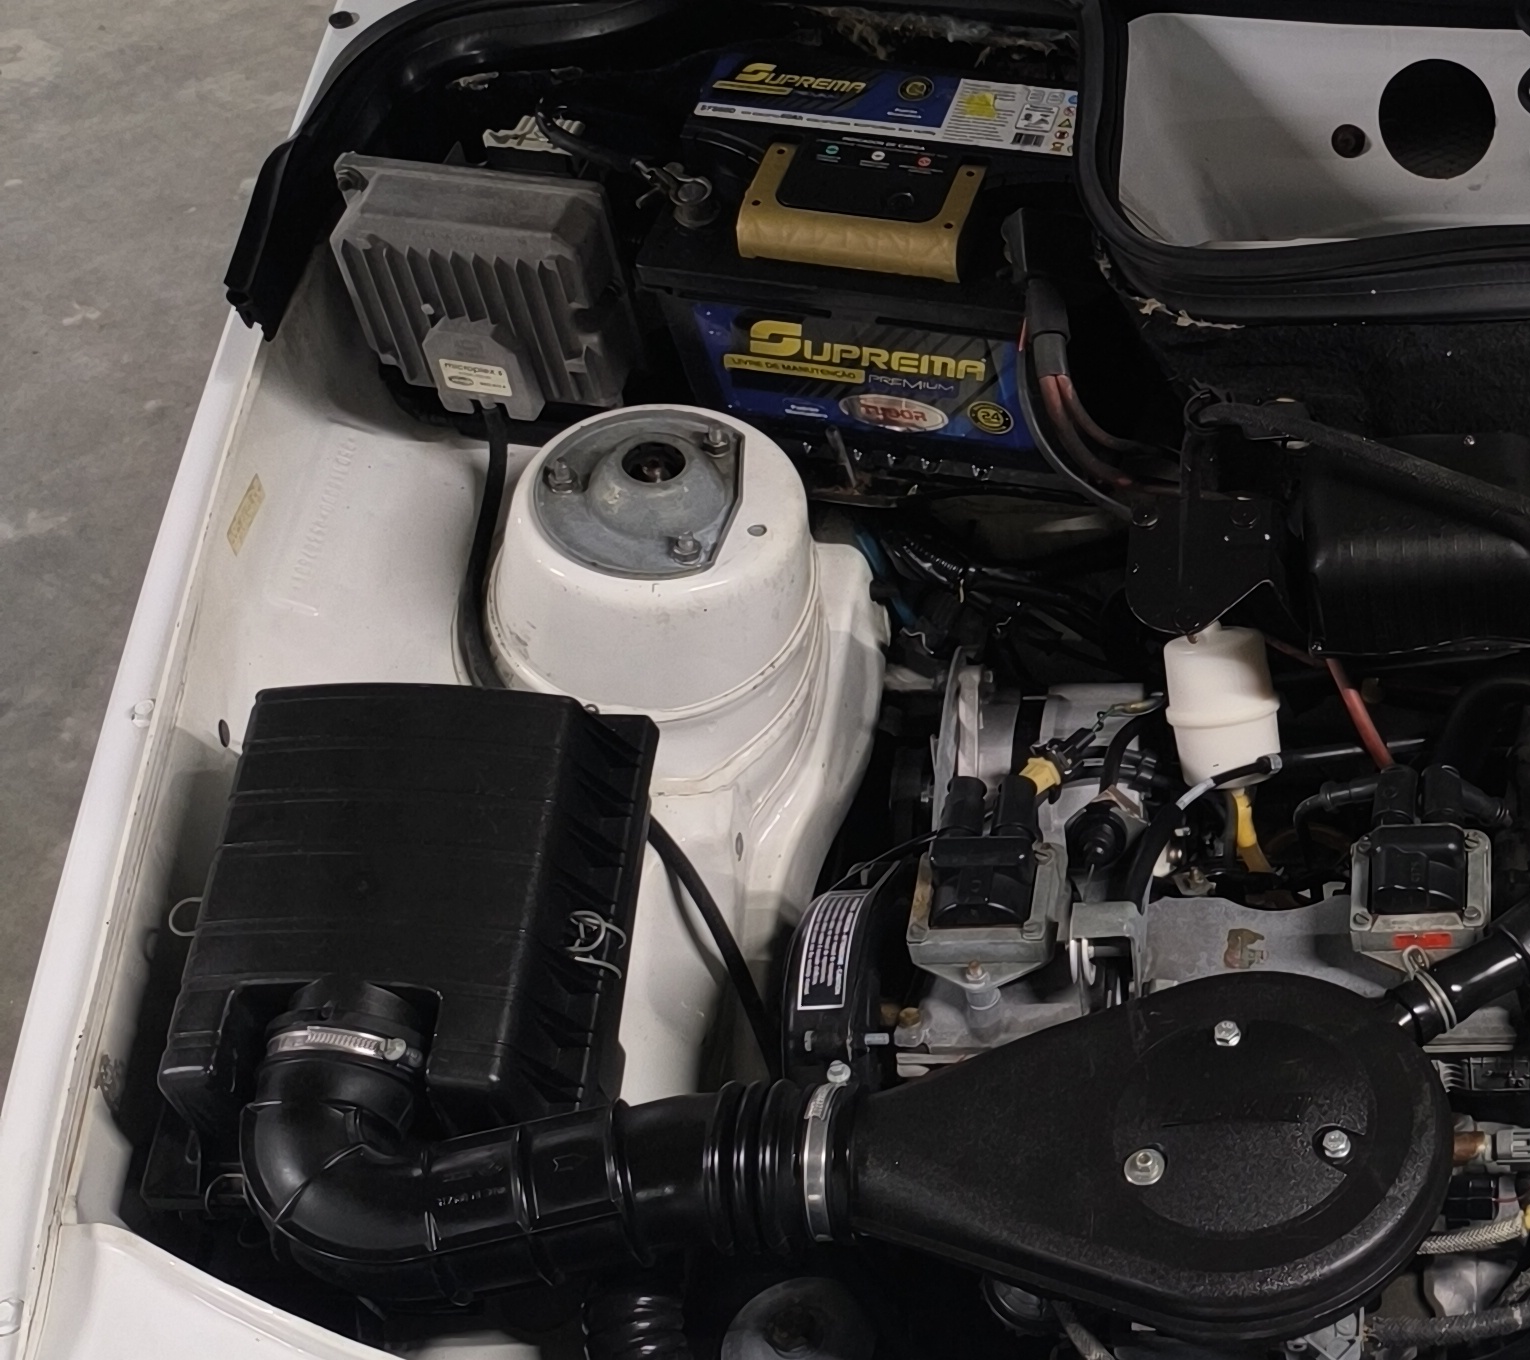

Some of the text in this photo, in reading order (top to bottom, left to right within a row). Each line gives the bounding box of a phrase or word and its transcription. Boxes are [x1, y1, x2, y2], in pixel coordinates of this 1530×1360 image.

[735, 62, 867, 93] SUPREMA
[750, 320, 986, 382] SUPREMA
[868, 374, 955, 392] PREMIUM
